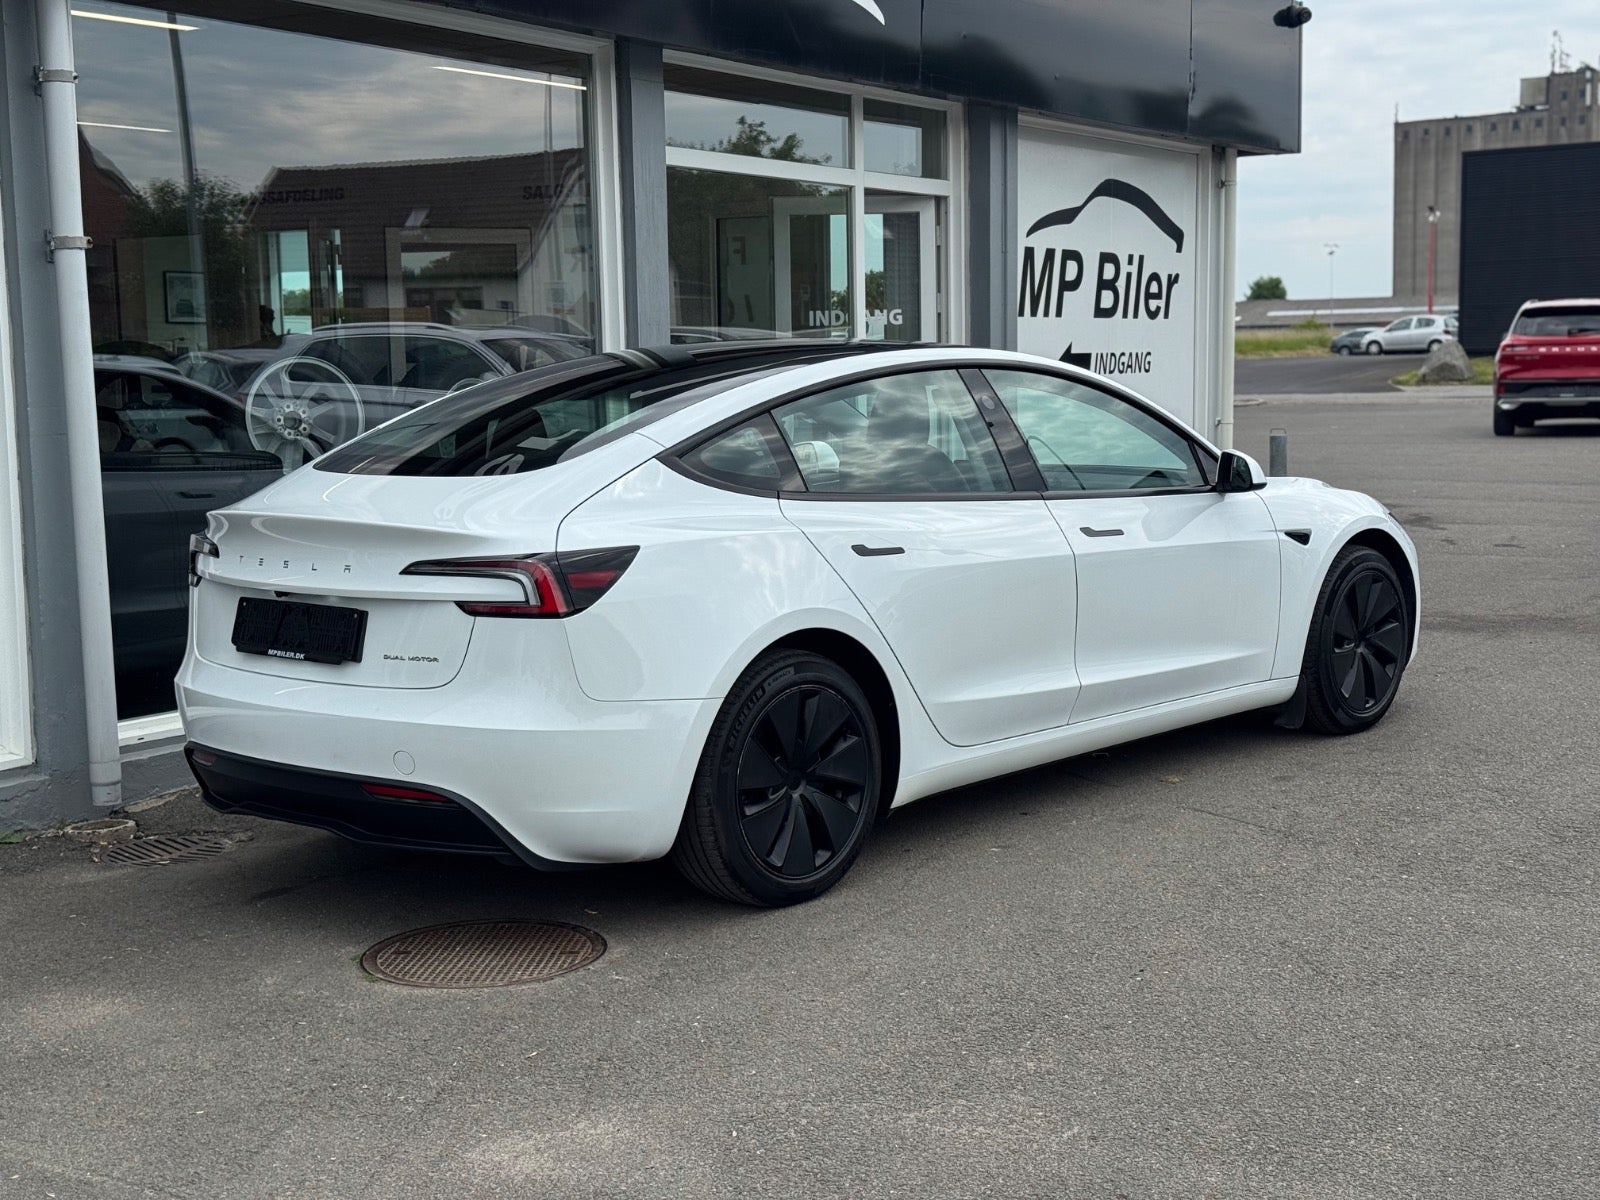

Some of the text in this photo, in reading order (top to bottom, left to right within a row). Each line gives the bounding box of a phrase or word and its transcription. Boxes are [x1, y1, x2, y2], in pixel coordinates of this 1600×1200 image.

[1017, 246, 1180, 320] MP Biler
[808, 308, 903, 327] INDANG
[1094, 352, 1152, 375] INDGANG
[238, 555, 352, 574] TESLA
[267, 648, 306, 660] MPBILER.DK
[407, 655, 440, 663] MOTOR
